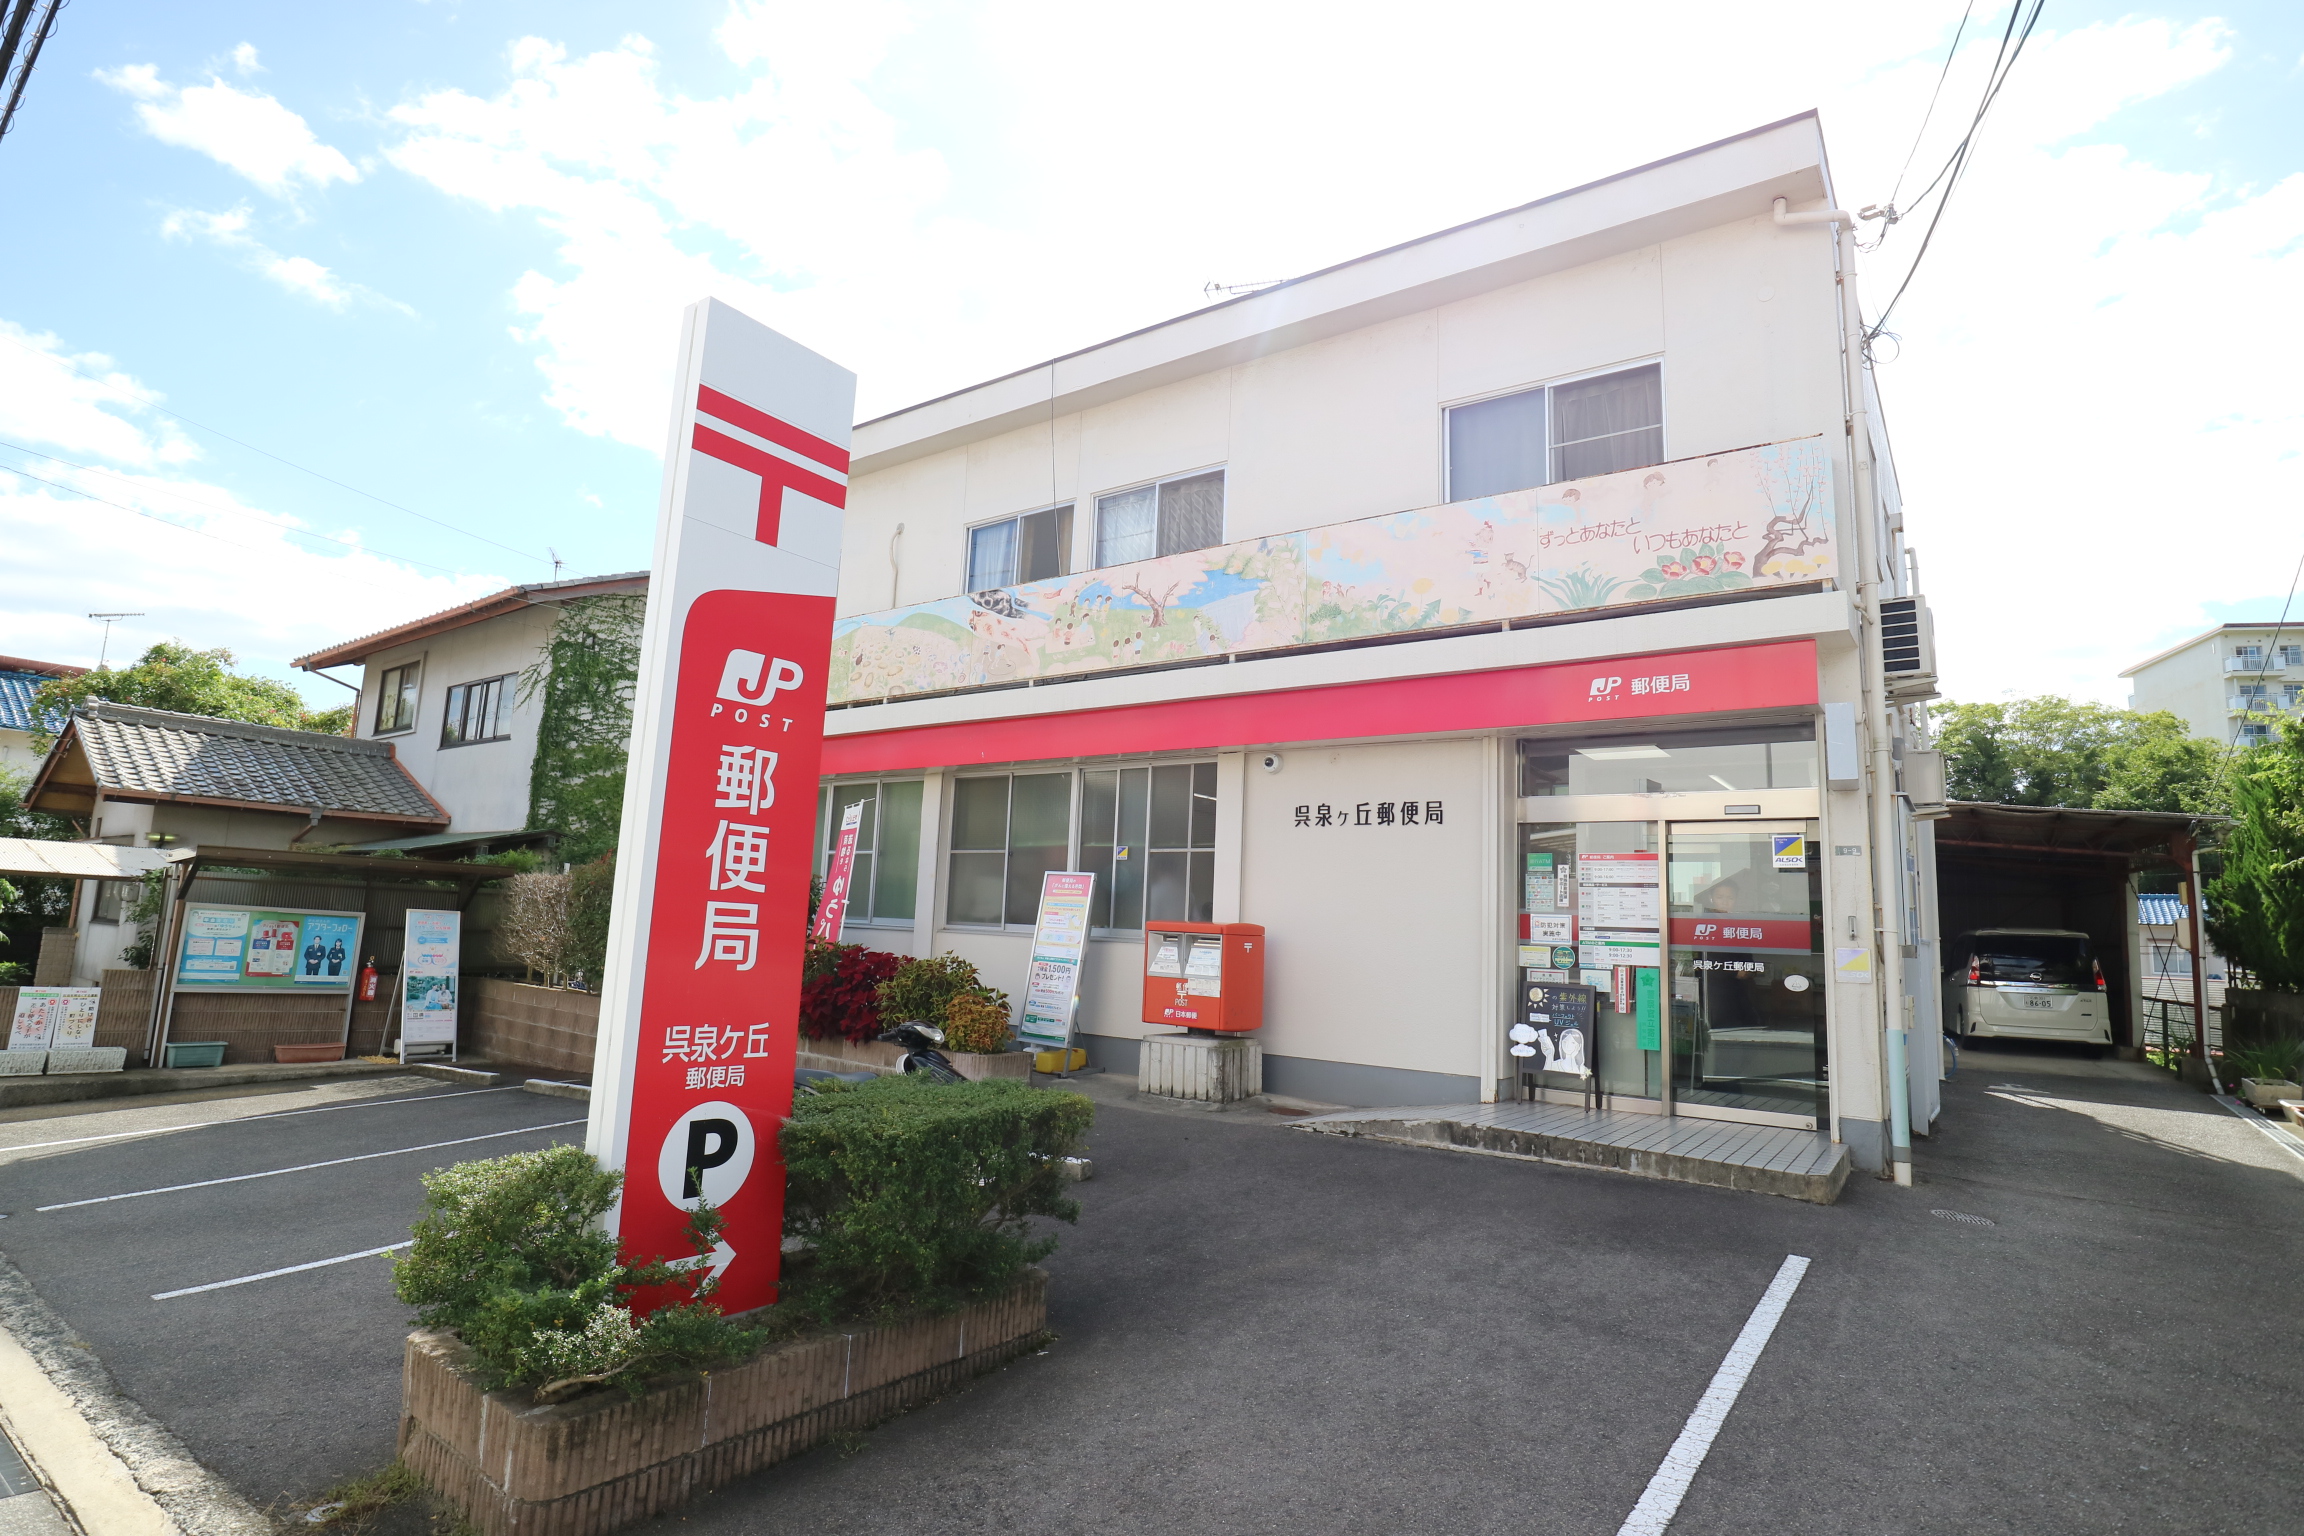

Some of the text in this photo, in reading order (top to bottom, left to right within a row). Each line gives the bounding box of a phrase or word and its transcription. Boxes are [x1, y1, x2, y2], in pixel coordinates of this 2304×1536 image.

[1539, 517, 1642, 549] ずっとあなたと
[1633, 520, 1749, 555] いつもあなたと
[1631, 673, 1690, 696] 郵便局
[1588, 694, 1620, 703] POST
[710, 702, 794, 733] POST
[694, 743, 780, 972] 郵便局
[307, 922, 353, 932] アフターフォロー
[1722, 927, 1763, 940] 郵便局
[1174, 998, 1188, 1006] POST
[1175, 1010, 1198, 1020] 日本郵便
[36, 1002, 46, 1031] あたたかく
[75, 1002, 86, 1039] ひとりにしない
[86, 1007, 94, 1028] 助け合い
[1647, 990, 1655, 1048] 警察官立寄所
[684, 1065, 746, 1091] 郵便局
[682, 1117, 740, 1200] P
